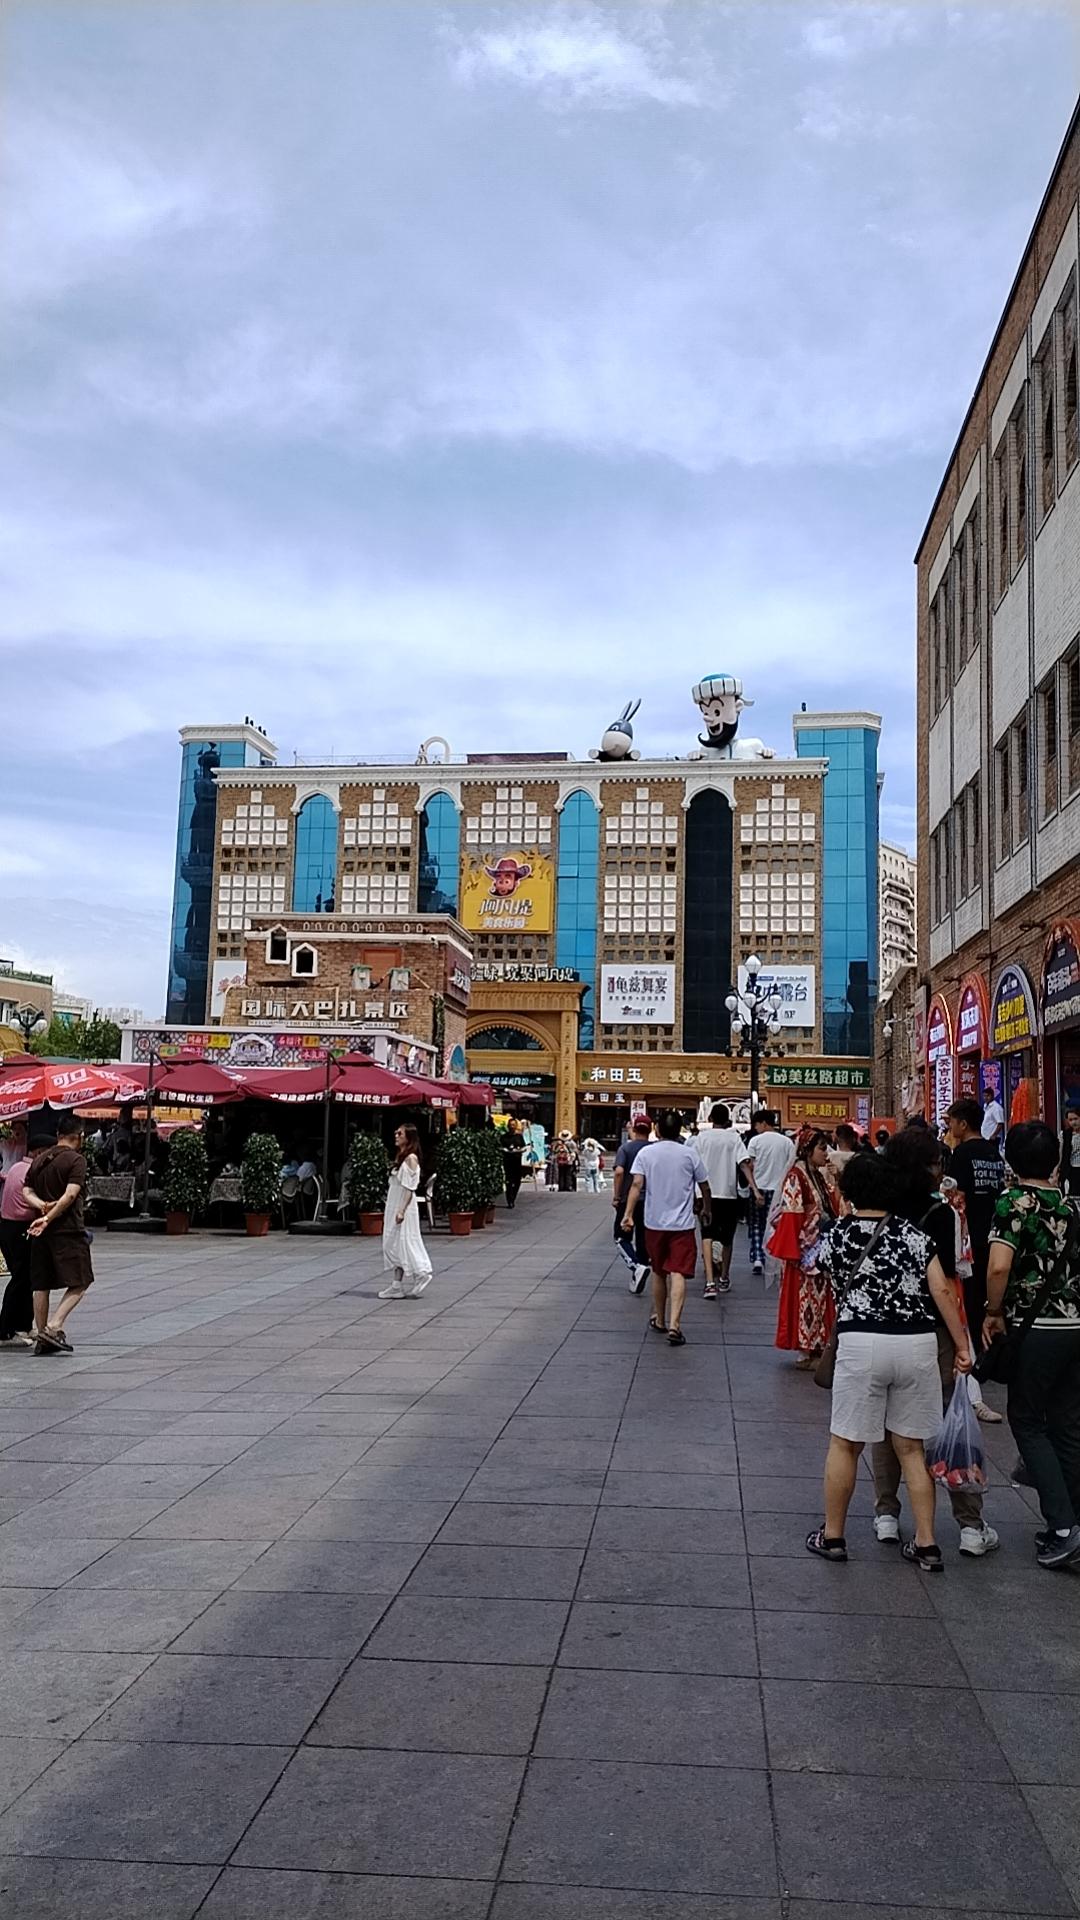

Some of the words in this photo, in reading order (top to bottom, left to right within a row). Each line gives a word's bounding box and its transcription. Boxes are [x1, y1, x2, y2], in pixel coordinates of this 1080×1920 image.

[478, 898, 534, 917] 阿凡提
[241, 999, 409, 1019] 国际大巴扎景区
[645, 1007, 656, 1017] 4F
[590, 1066, 644, 1084] 和田玉
[583, 1092, 626, 1104] 和田玉
[791, 1103, 848, 1118] 干果超市
